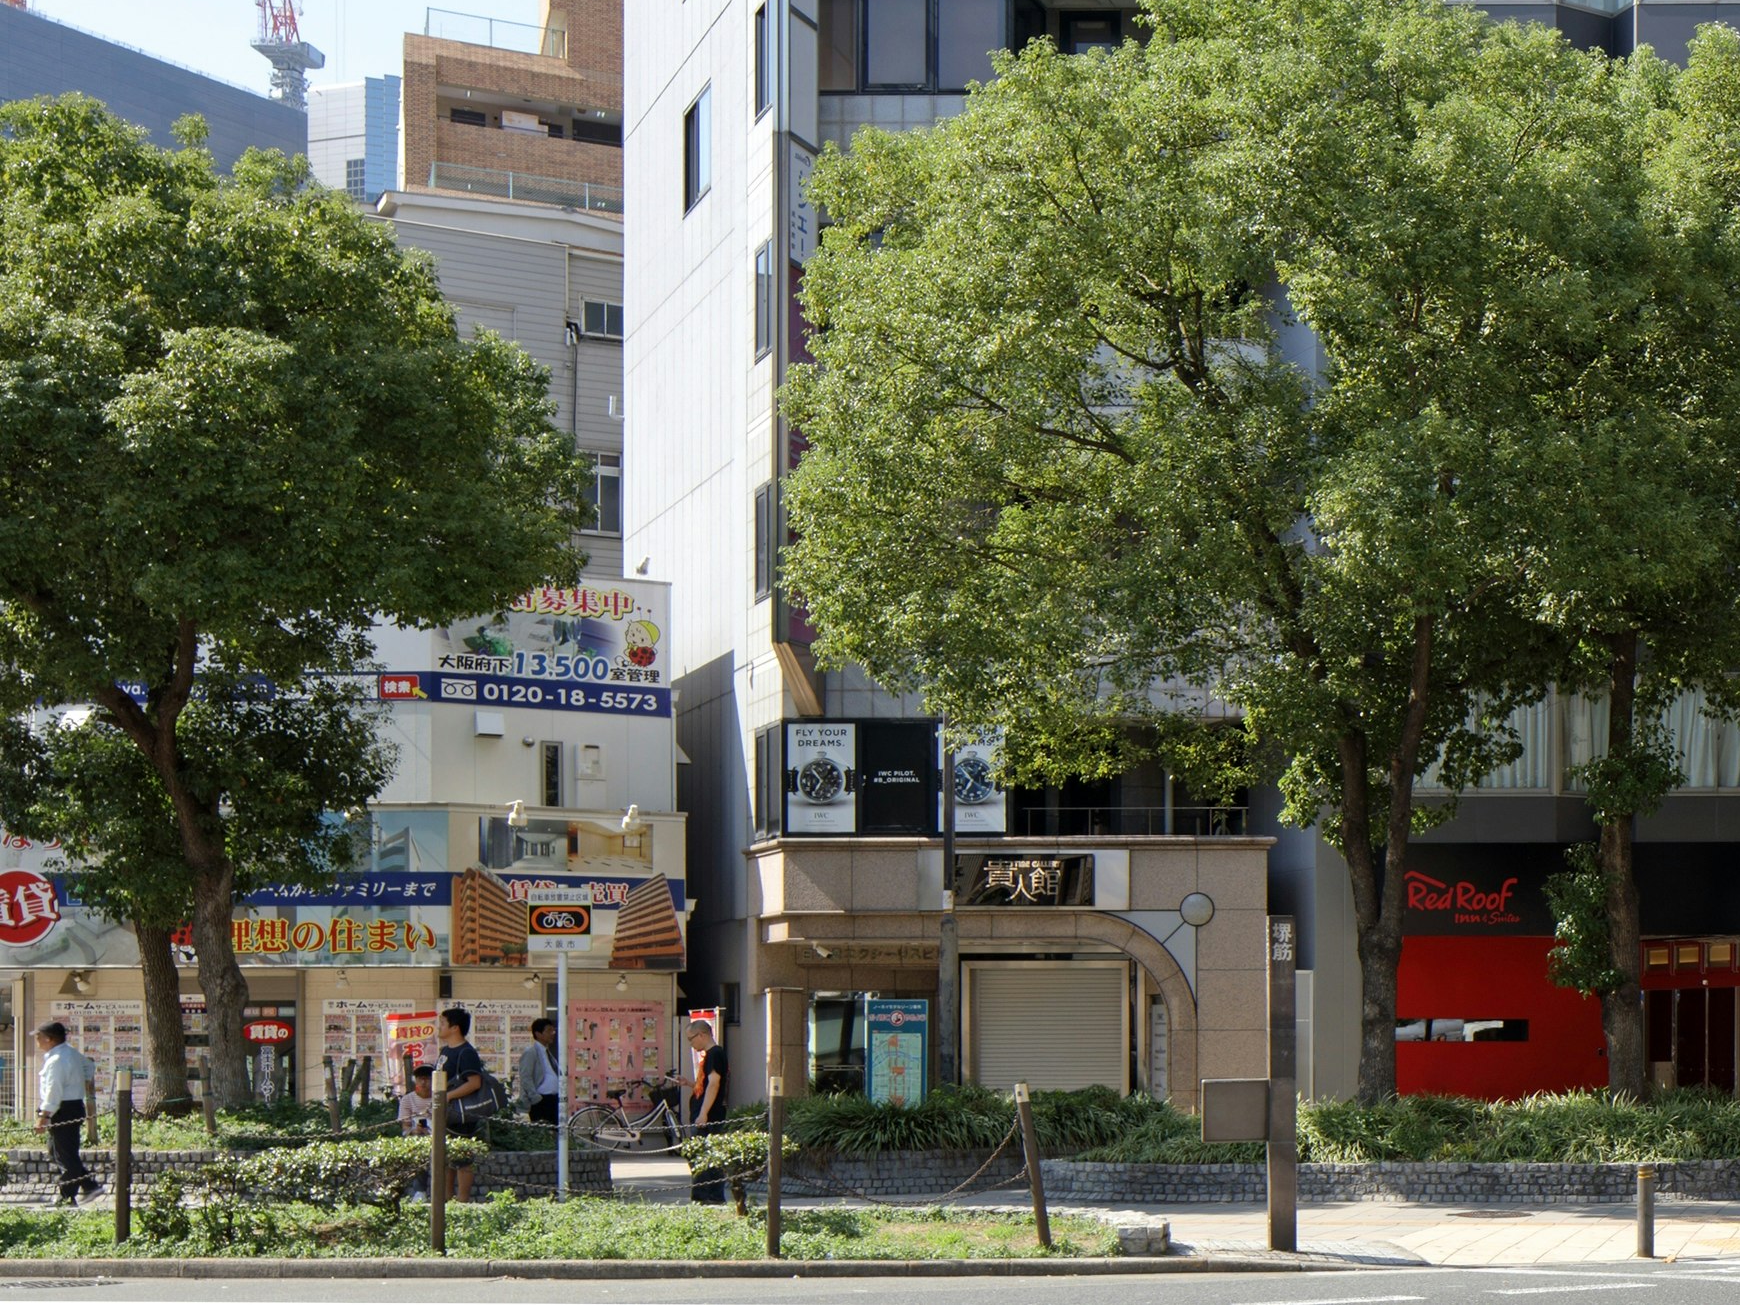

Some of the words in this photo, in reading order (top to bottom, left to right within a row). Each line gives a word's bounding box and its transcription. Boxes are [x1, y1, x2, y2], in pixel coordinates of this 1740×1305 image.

[384, 678, 411, 694] 検索
[484, 683, 658, 711] 0120-18-5573
[795, 729, 814, 737] FLY
[818, 729, 847, 737] YOUR
[798, 739, 845, 747] DREAMS.
[984, 860, 1061, 902] 貴人館
[1408, 881, 1454, 911] Red
[1456, 878, 1518, 912] Roof
[231, 918, 436, 953] 理想の住まい
[544, 939, 575, 948] 大阪市
[1272, 923, 1292, 961] 堺筋
